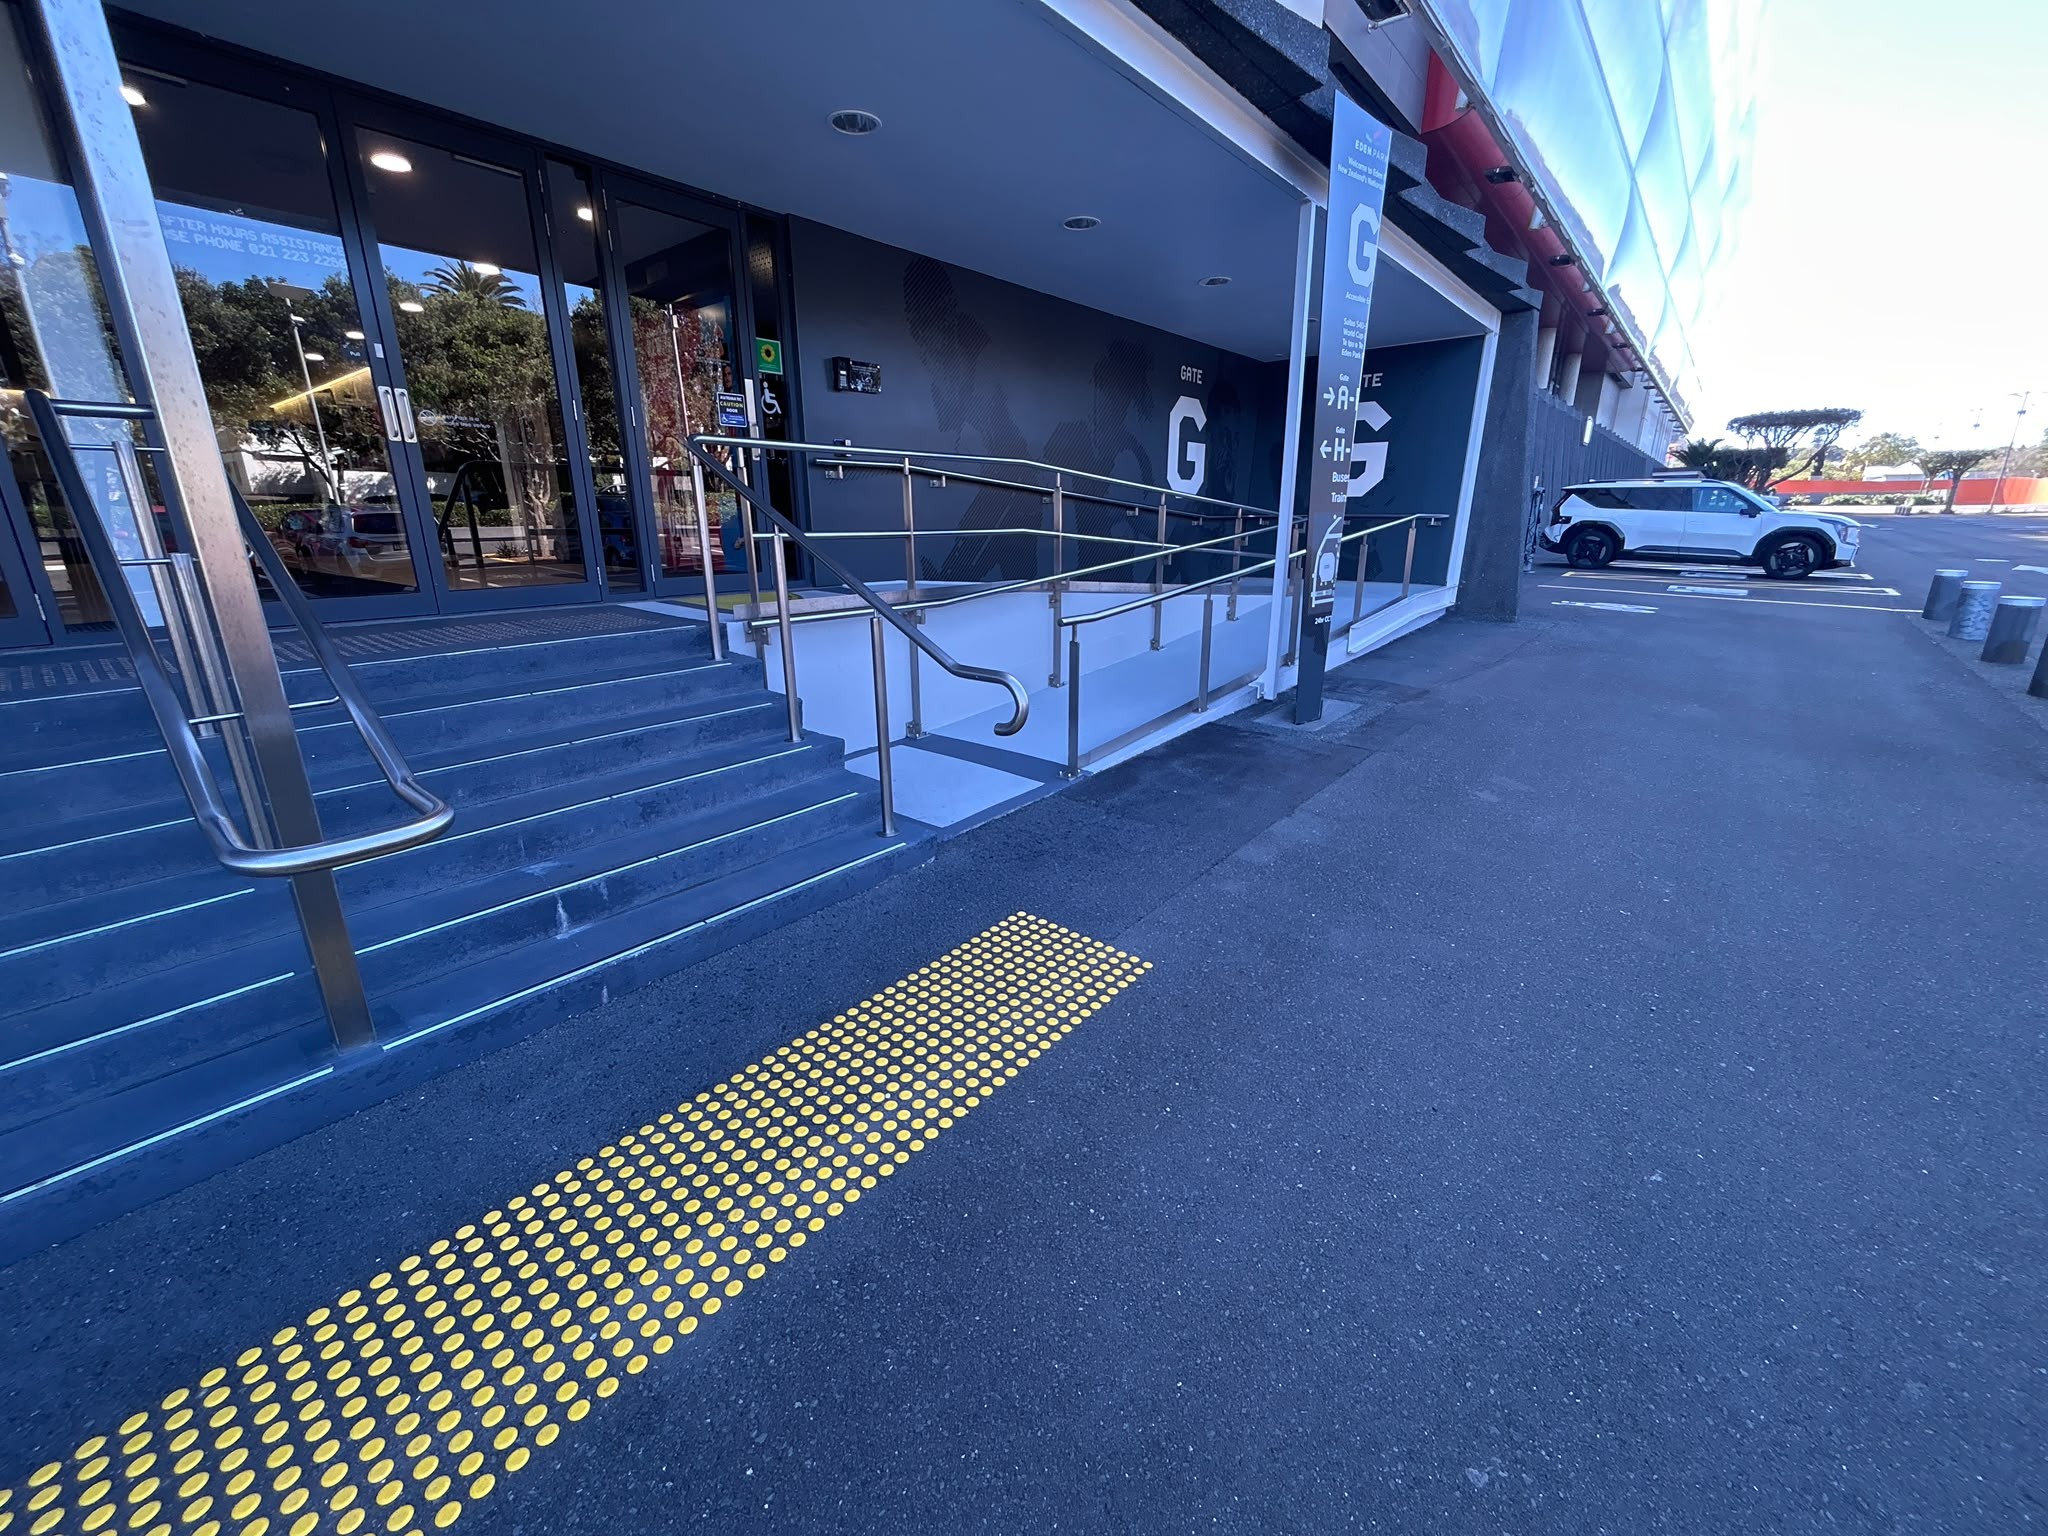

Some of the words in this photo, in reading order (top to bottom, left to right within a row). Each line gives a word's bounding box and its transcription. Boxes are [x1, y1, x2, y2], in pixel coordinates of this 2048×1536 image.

[1355, 139, 1372, 156] EDEN
[1337, 163, 1348, 175] New
[1348, 168, 1367, 184] Zealand's
[1348, 156, 1367, 173] Welcome
[1367, 166, 1373, 175] to
[1373, 168, 1383, 179] Eden
[193, 233, 245, 253] PHONE
[248, 244, 278, 258] 021
[281, 248, 309, 263] 223
[210, 223, 258, 242] HOURS
[261, 232, 345, 257] ASSISTANCE
[1347, 203, 1379, 288] G
[1343, 328, 1355, 337] World
[1355, 330, 1364, 340] Cup
[1341, 348, 1352, 357] Eden
[1352, 350, 1361, 359] Park
[1180, 365, 1203, 385] GATE
[1339, 373, 1350, 382] Gate
[1362, 372, 1384, 388] TE
[720, 400, 744, 408] CAUTION
[1335, 426, 1346, 434] Gate
[1166, 395, 1207, 499] G
